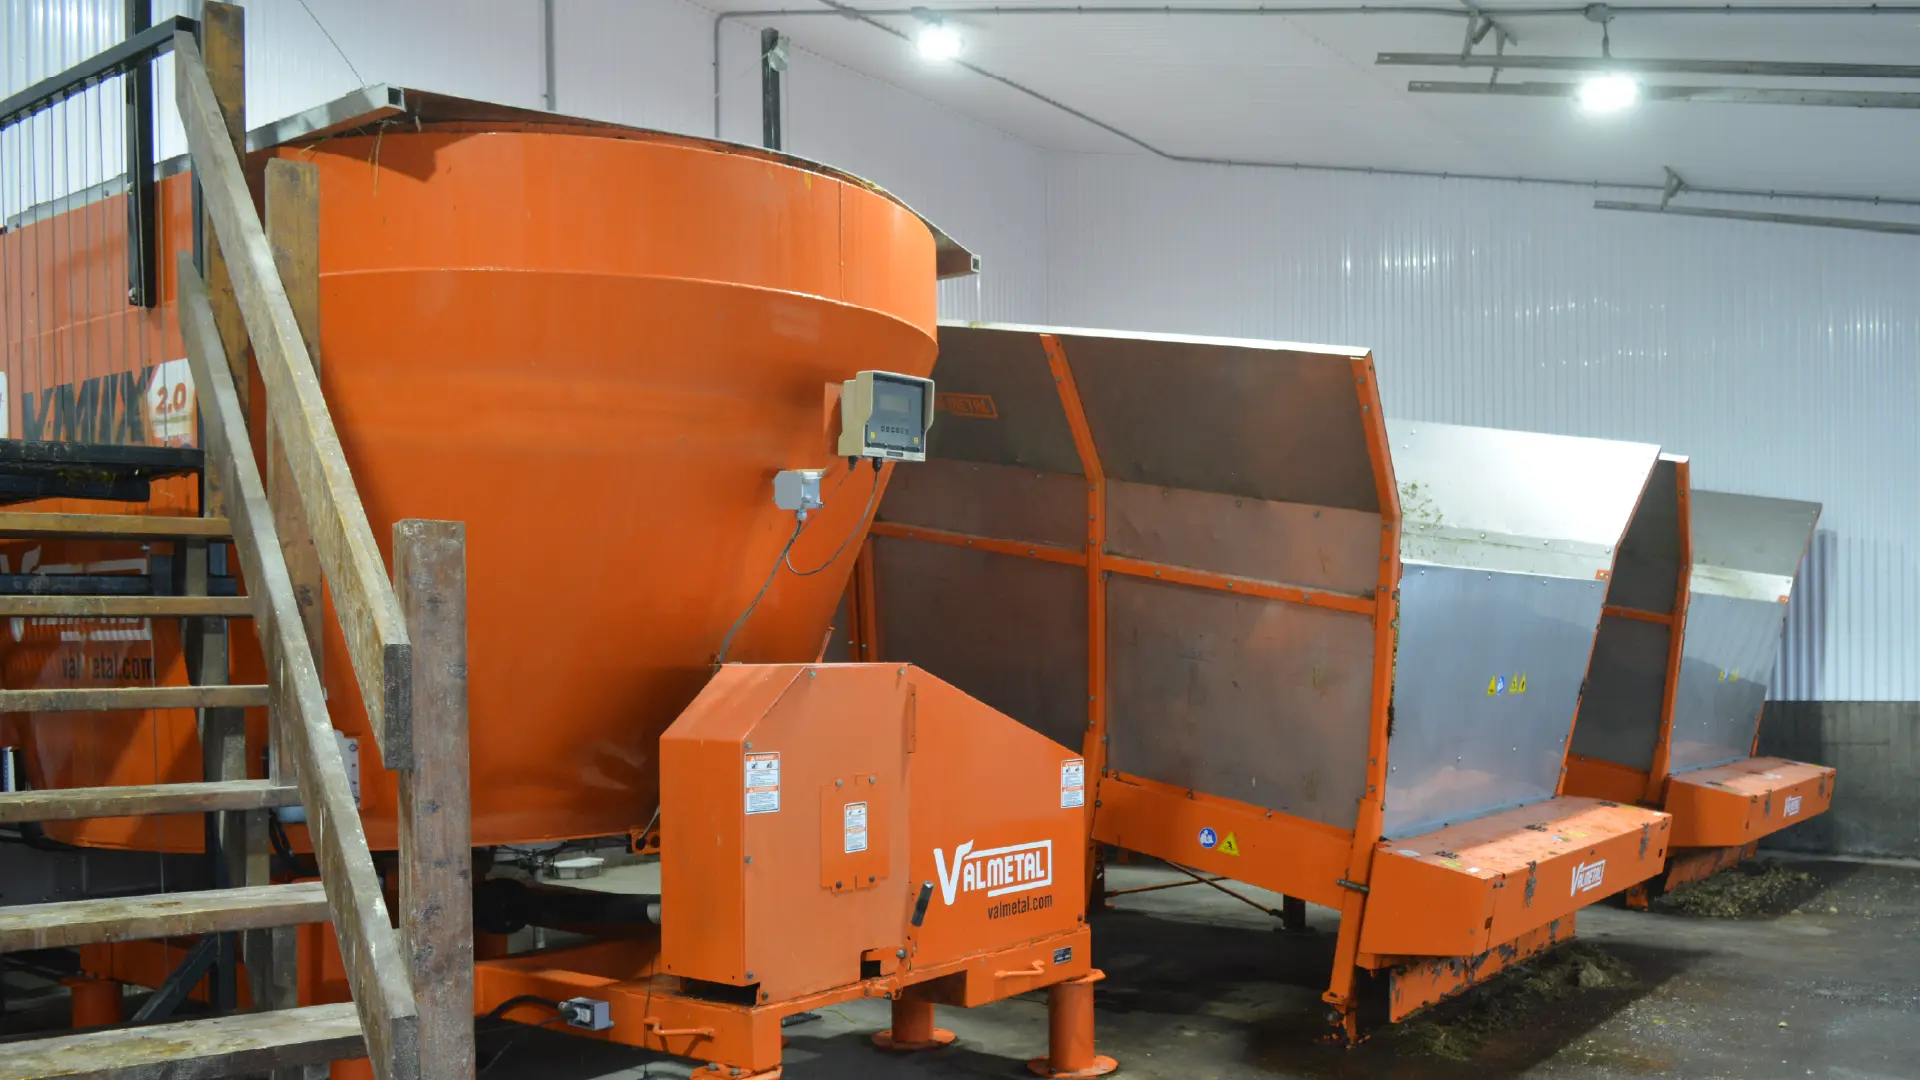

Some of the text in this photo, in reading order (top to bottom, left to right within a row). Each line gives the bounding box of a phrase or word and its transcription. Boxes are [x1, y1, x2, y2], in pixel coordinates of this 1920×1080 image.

[22, 366, 186, 444] VMIX 2.0
[62, 651, 158, 681] valetal.com
[933, 839, 1046, 906] VALMETAL
[987, 893, 1053, 920] valmetal.com
